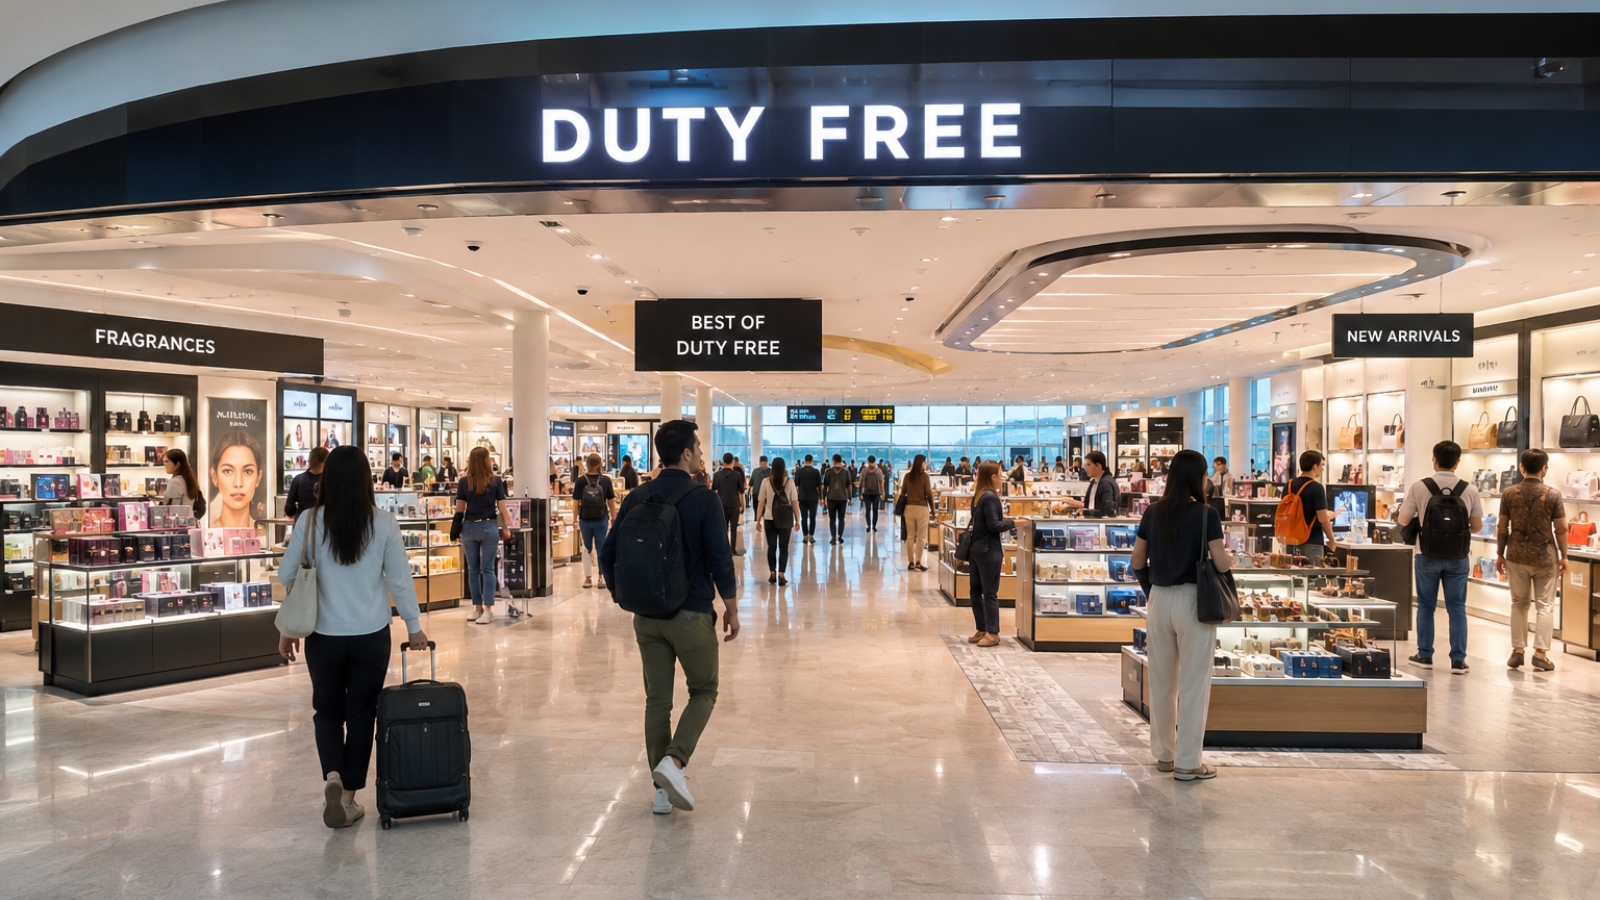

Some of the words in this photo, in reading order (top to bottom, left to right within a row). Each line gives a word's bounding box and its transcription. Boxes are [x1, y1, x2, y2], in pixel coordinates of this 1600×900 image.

[541, 106, 765, 164] DUTY
[810, 102, 1023, 161] FREE
[691, 314, 736, 331] BEST
[740, 314, 766, 331] OF
[94, 327, 217, 356] FRAGRANCES
[1347, 329, 1383, 344] NEW
[1386, 329, 1461, 344] ARRIVALS
[676, 339, 728, 357] DUTY
[733, 339, 781, 357] FREE
